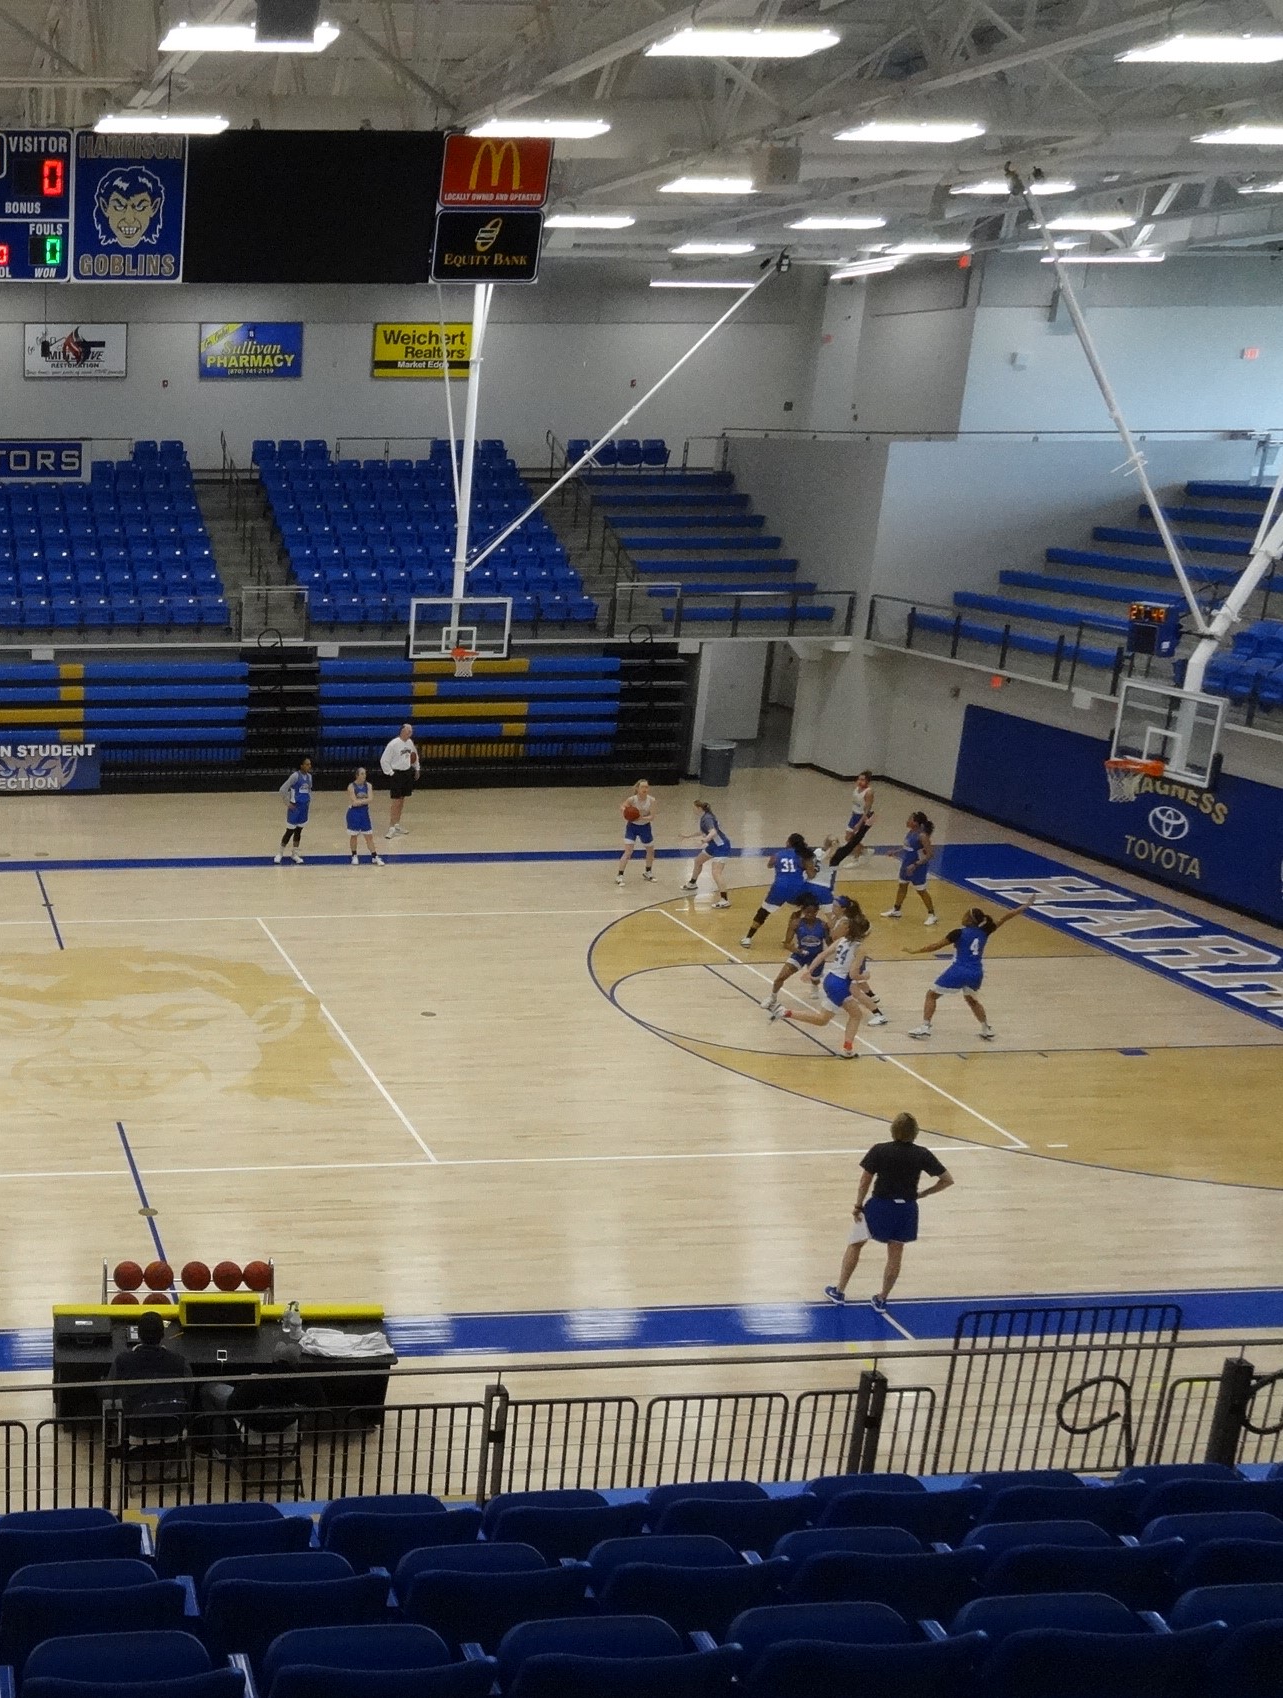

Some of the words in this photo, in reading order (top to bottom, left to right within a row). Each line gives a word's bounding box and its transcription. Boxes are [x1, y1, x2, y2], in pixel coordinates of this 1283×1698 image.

[9, 136, 68, 153] VISITOR
[78, 136, 183, 159] HARRISON
[43, 160, 64, 196] 0
[444, 193, 471, 201] LOCALLY
[495, 193, 509, 201] AND
[5, 202, 41, 214] BONUS
[29, 223, 63, 235] FOULS
[46, 239, 60, 264] 0
[34, 268, 56, 278] WON
[79, 254, 175, 276] GOBLINS
[222, 341, 281, 355] Sullivan
[206, 354, 295, 369] PHARMACY
[16, 744, 96, 757] STUDENT
[1124, 773, 1228, 825] AGNESS
[1125, 834, 1200, 880] TOYOTA
[780, 858, 796, 873] 31
[970, 937, 980, 956] 4
